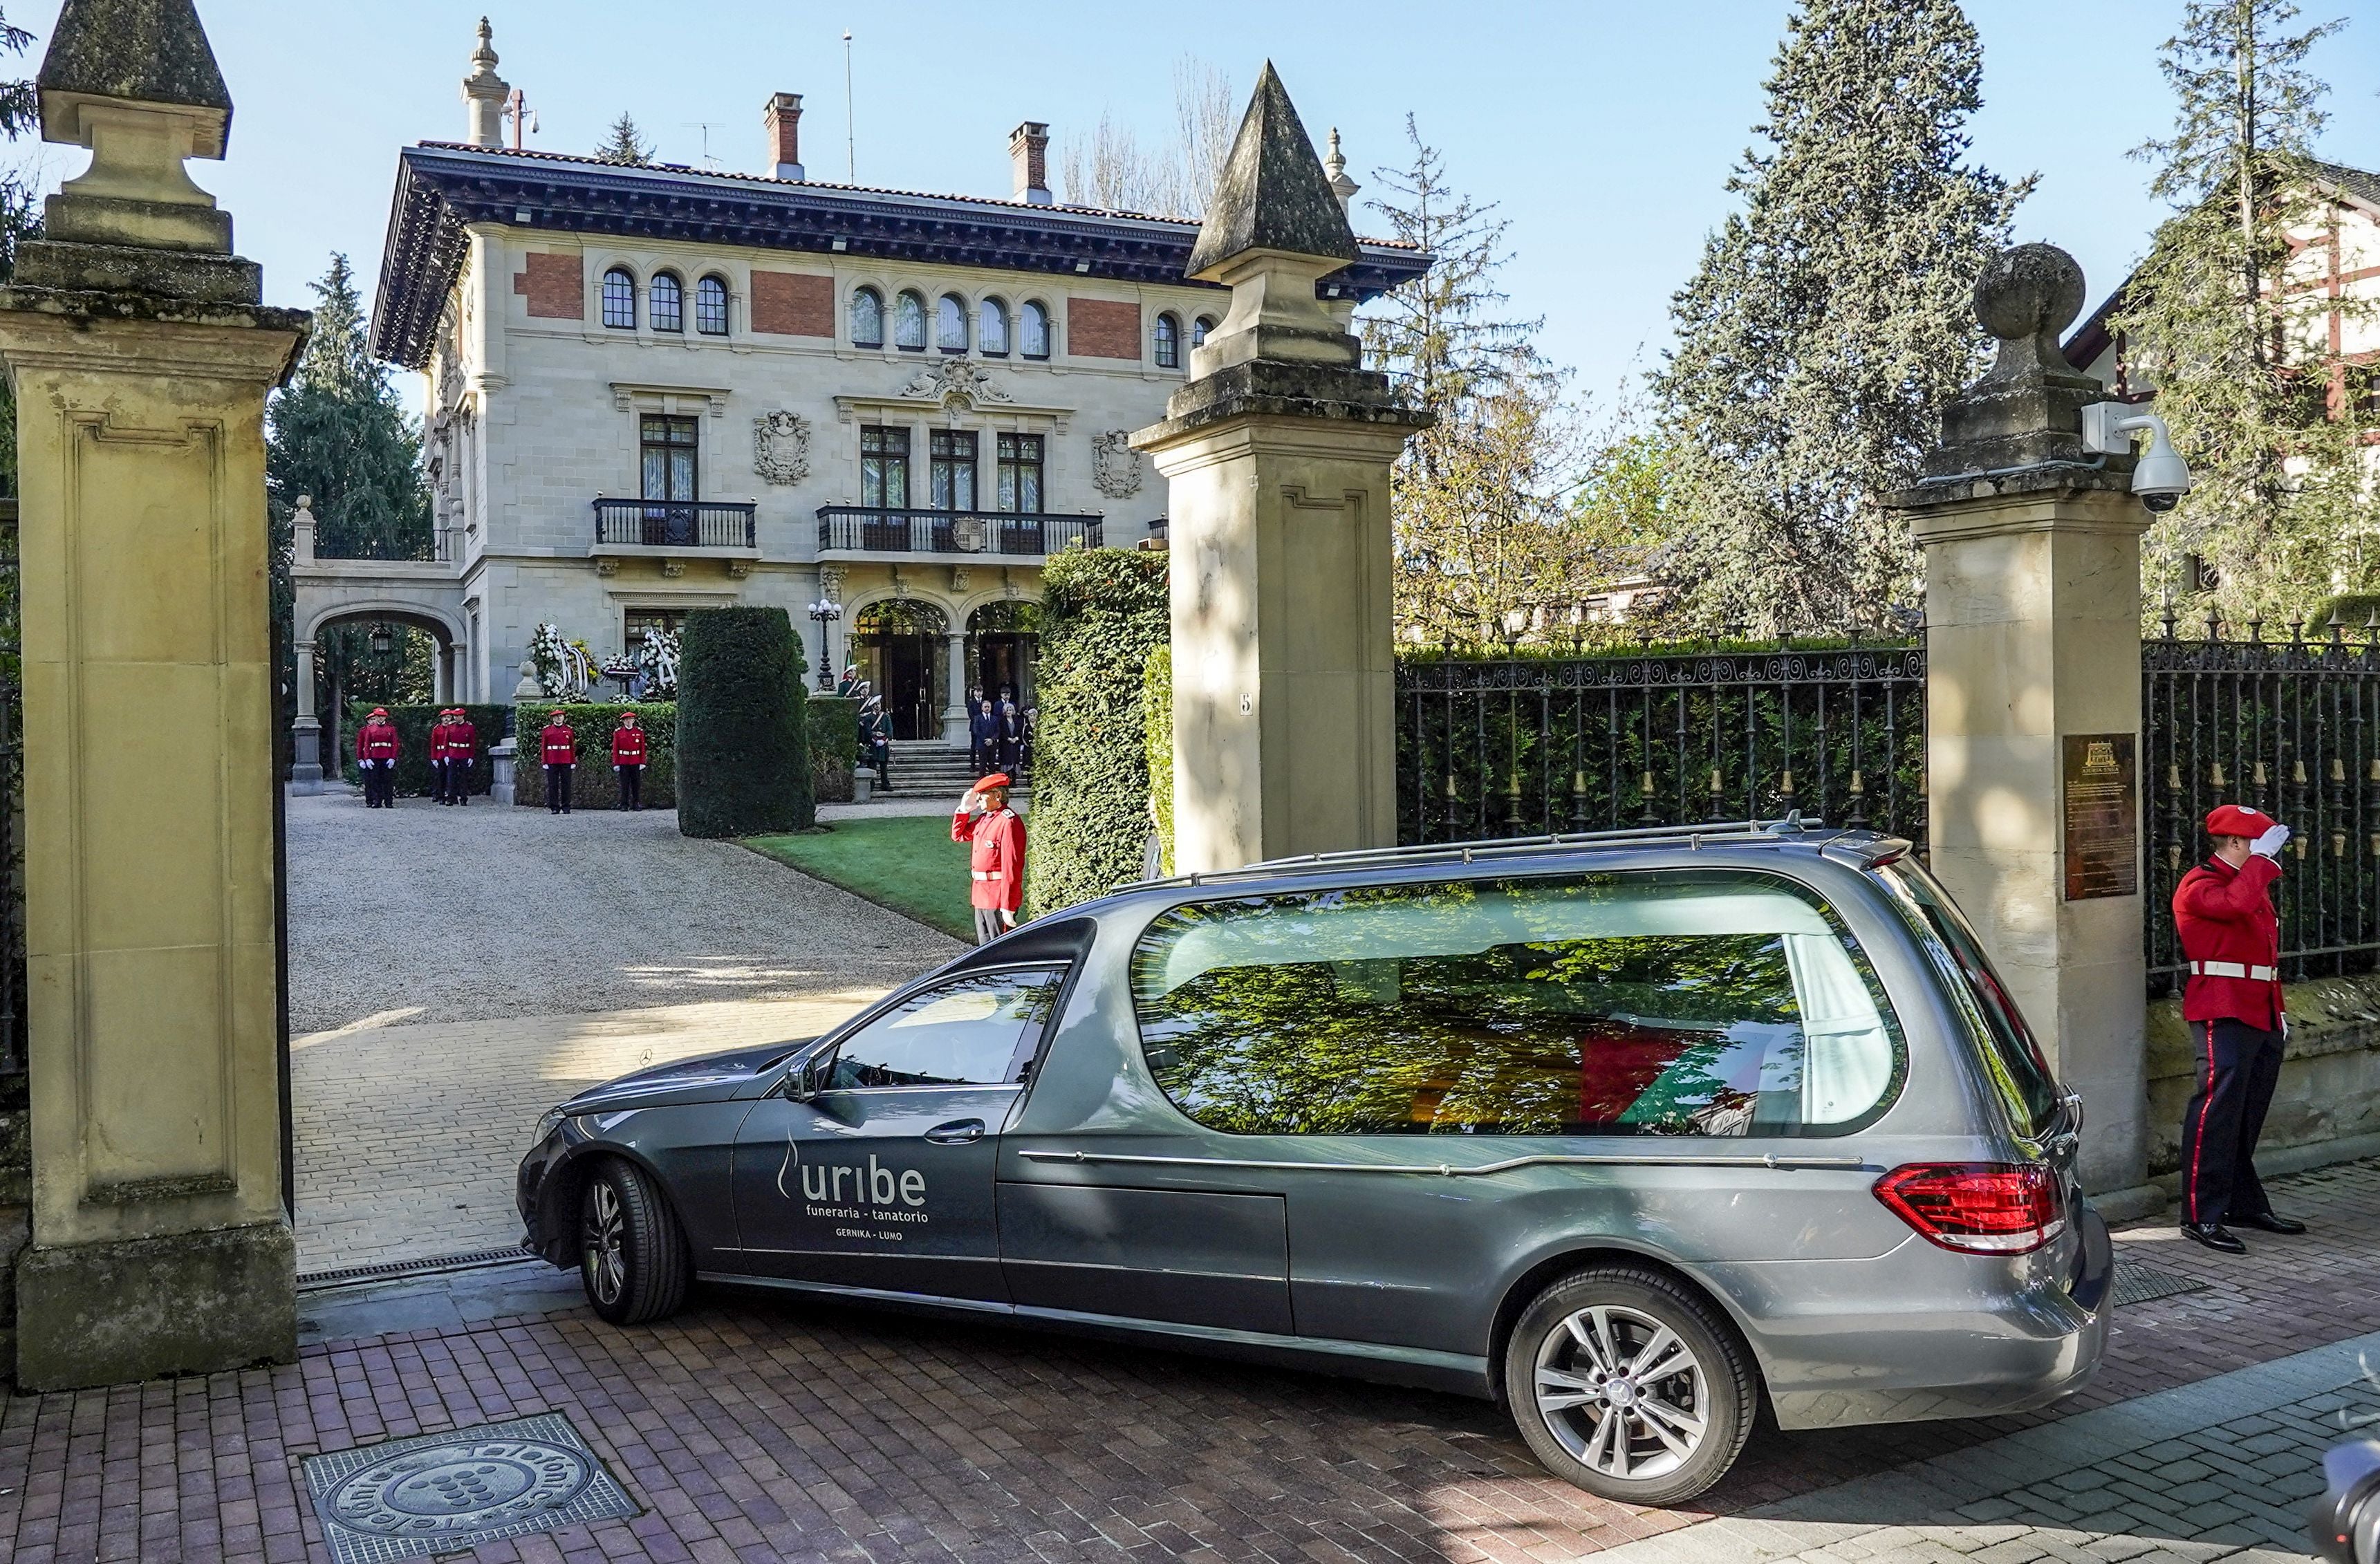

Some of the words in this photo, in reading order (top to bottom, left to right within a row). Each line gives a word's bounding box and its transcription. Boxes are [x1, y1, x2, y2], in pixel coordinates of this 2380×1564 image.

[1243, 693, 1250, 711] 5
[801, 1154, 926, 1207] uribe
[806, 1204, 859, 1220] funeraria
[872, 1210, 929, 1223] tanatorio
[835, 1228, 871, 1239] GERNIKA
[878, 1231, 903, 1241] LUMO
